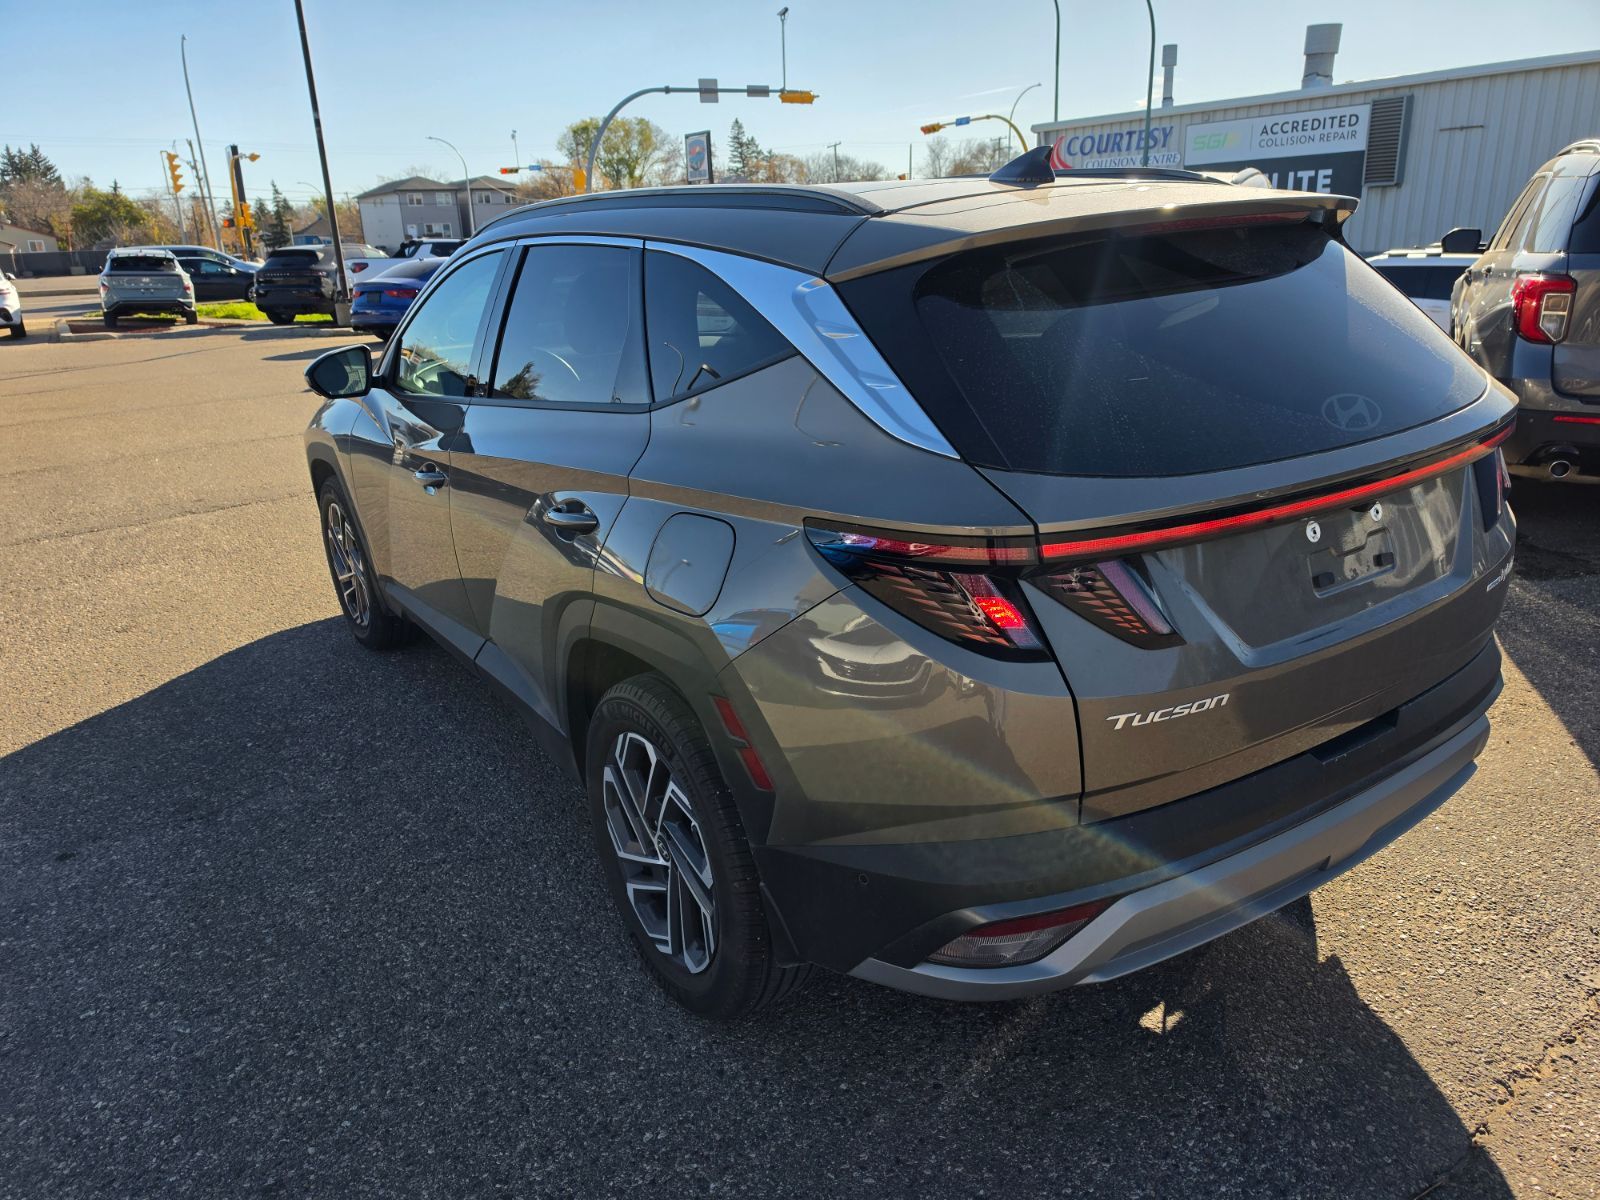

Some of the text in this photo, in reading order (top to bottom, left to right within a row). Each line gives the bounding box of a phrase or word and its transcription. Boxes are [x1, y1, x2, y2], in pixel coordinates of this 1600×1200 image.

[1260, 113, 1360, 136] ACCREDITED
[1066, 125, 1174, 157] COURTESY
[1192, 132, 1228, 150] SGI
[1258, 130, 1357, 149] COLLISION REPAIR
[1105, 693, 1230, 730] TUCSON
